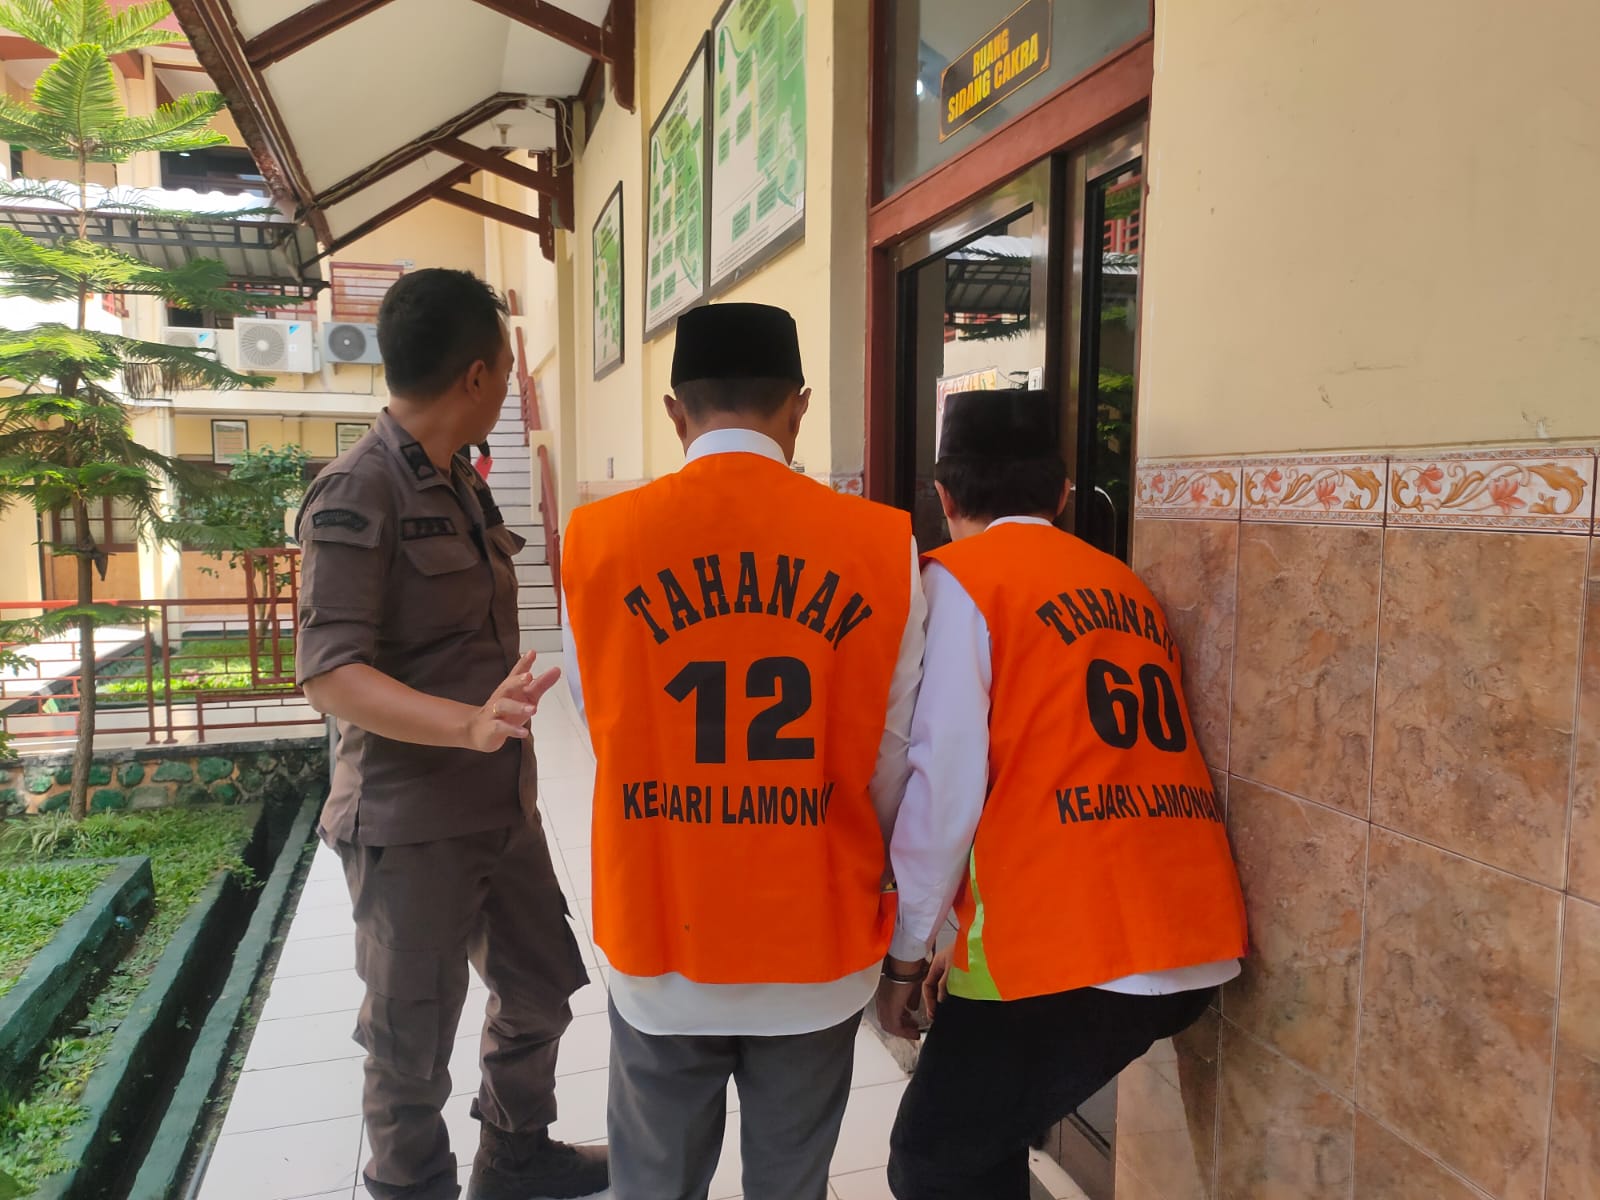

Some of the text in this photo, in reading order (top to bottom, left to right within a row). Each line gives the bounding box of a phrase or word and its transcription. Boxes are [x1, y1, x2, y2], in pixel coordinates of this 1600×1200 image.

[947, 32, 1039, 124] SIDANG CAKRA
[973, 29, 1009, 77] RUANG
[624, 551, 872, 650] TAHANAN
[665, 656, 815, 764] 12
[1086, 658, 1187, 752] 60
[622, 780, 711, 824] KEJARI
[1056, 784, 1141, 825] KEJARI
